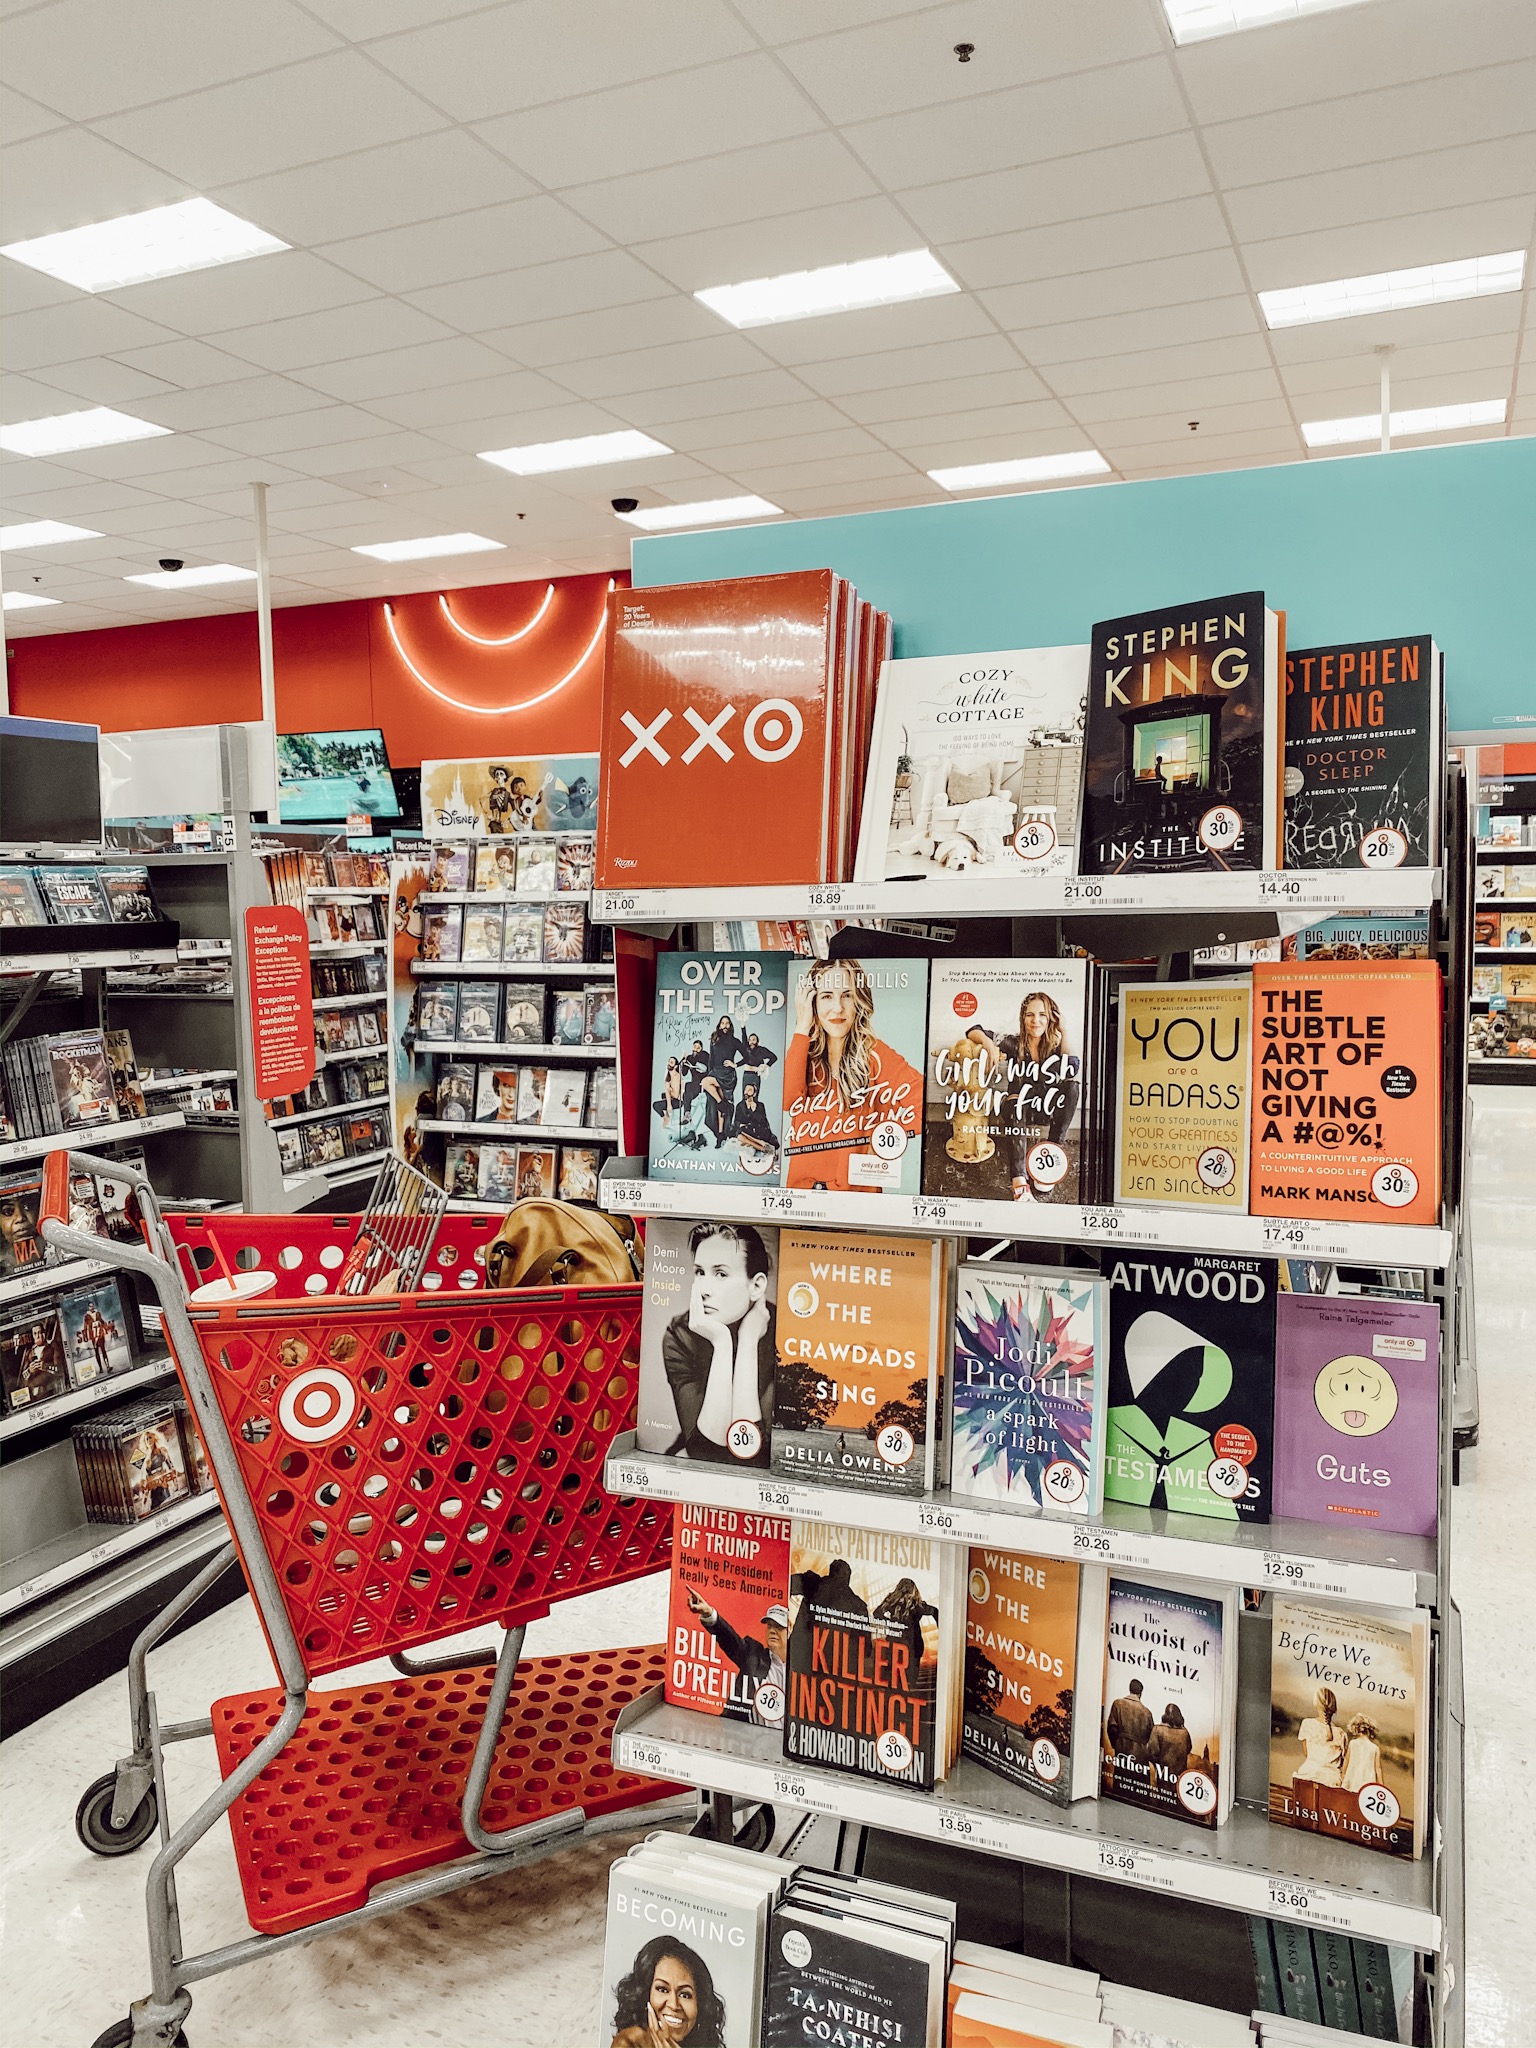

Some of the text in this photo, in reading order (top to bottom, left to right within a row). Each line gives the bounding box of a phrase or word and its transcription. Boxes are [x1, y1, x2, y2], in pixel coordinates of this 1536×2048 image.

[623, 619, 654, 629] of Design
[632, 612, 650, 620] Years
[1106, 612, 1246, 661] STEPHEN
[959, 670, 1014, 685] COZY
[1104, 647, 1250, 709] KING
[956, 684, 1009, 707] white
[936, 707, 1025, 724] COTTAGE
[1311, 690, 1385, 732] KING
[1306, 747, 1387, 766] DOCTOR
[1319, 766, 1374, 781] SLEEP
[223, 820, 234, 846] F15
[1161, 825, 1179, 833] THE
[396, 841, 417, 851] Recent
[1100, 832, 1245, 862] INSTITUE
[808, 893, 841, 905] 18.89
[1064, 885, 1102, 898] 21.00
[1259, 882, 1301, 896] 14.40
[605, 900, 635, 910] 21.00
[253, 924, 278, 935] Refund/
[254, 934, 303, 945] Exchange Policy
[1305, 930, 1428, 942] BIG. JUICY. DELICIOUS
[255, 946, 288, 956] Exceptions
[680, 960, 763, 986] OVER
[798, 972, 909, 989] RACHEL HOLLIS
[258, 994, 296, 1006] Excepciones
[659, 989, 786, 1015] THE TOP
[1261, 990, 1323, 1013] THE
[259, 1025, 298, 1037] devoluciones
[1261, 1016, 1386, 1039] SUBTLE
[1131, 1017, 1240, 1062] YOU
[1261, 1042, 1383, 1066] ART OF
[935, 1048, 1075, 1089] Girl, wash
[1167, 1067, 1198, 1076] are a
[1262, 1068, 1329, 1091] NOT
[789, 1081, 911, 1117] GIRL, STOP
[945, 1083, 1066, 1121] your face
[1261, 1094, 1377, 1119] GIVING
[785, 1104, 916, 1143] APOLOGIZING
[962, 1125, 1041, 1137] RACHEL HOLLIS
[1261, 1120, 1283, 1143] A
[1128, 1127, 1238, 1143] YOUR GREATNESS
[651, 1158, 743, 1173] JONATHAN VAN
[1129, 1176, 1156, 1191] JEN
[1261, 1185, 1310, 1200] MARK
[613, 1190, 642, 1201] 19.59
[762, 1197, 793, 1209] 17.49
[913, 1206, 946, 1218] 17.49
[1081, 1216, 1118, 1229] 12.80
[1263, 1229, 1304, 1242] 17.49
[13, 1238, 41, 1265] MA
[653, 1245, 679, 1258] Demi
[652, 1261, 686, 1275] Moore
[809, 1262, 892, 1287] WHERE
[1194, 1257, 1261, 1273] MARGARET
[651, 1277, 681, 1292] Inside
[1110, 1261, 1266, 1304] ATWOOD
[651, 1293, 670, 1306] Out
[826, 1302, 872, 1325] THE
[1319, 1312, 1394, 1327] Raina Telgemeier
[784, 1337, 916, 1370] CRAWDADS
[994, 1337, 1051, 1365] Jodi
[963, 1357, 1087, 1401] Picoult
[816, 1381, 877, 1406] SING
[986, 1409, 1060, 1431] a spark
[985, 1430, 1058, 1455] of light
[1117, 1443, 1136, 1456] THE
[785, 1445, 835, 1465] DELIA
[620, 1473, 649, 1485] 19.59
[1316, 1453, 1392, 1487] Guts
[758, 1491, 789, 1505] 18.20
[681, 1504, 738, 1533] UNITED
[919, 1513, 952, 1528] 13.60
[1333, 1505, 1380, 1517] SCHOLASTIC
[681, 1527, 761, 1561] OF TRUMP
[797, 1521, 931, 1571] JAMES PATTERSON
[1073, 1535, 1110, 1550] 20.26
[680, 1551, 773, 1581] How the President
[983, 1550, 1046, 1590] WHERE
[1264, 1562, 1304, 1579] 12.99
[679, 1567, 784, 1600] Really Sees America
[994, 1593, 1030, 1624] THE
[1143, 1612, 1160, 1625] The
[674, 1626, 722, 1664] BILL
[966, 1621, 1063, 1678] CRAWDADS
[1110, 1621, 1209, 1656] attooist of
[1278, 1631, 1371, 1667] Before We
[812, 1625, 909, 1692] KILLER
[987, 1669, 1032, 1706] SING
[1305, 1660, 1407, 1701] Were Yours
[790, 1671, 927, 1746] INSTINCT
[788, 1722, 855, 1767] & HOWARD
[964, 1724, 1000, 1755] DELIA
[632, 1750, 661, 1765] 19.60
[775, 1781, 805, 1797] 19.60
[938, 1818, 972, 1834] 13.59
[1283, 1798, 1399, 1844] Lisa Wingate
[1098, 1853, 1135, 1871] 13.59
[1269, 1890, 1308, 1908] 13.60
[616, 1892, 746, 1947] BECOMING
[801, 1971, 894, 2007] BETWEEN THE WORLD AND ME
[789, 1986, 903, 2042] TA-NEHISI
